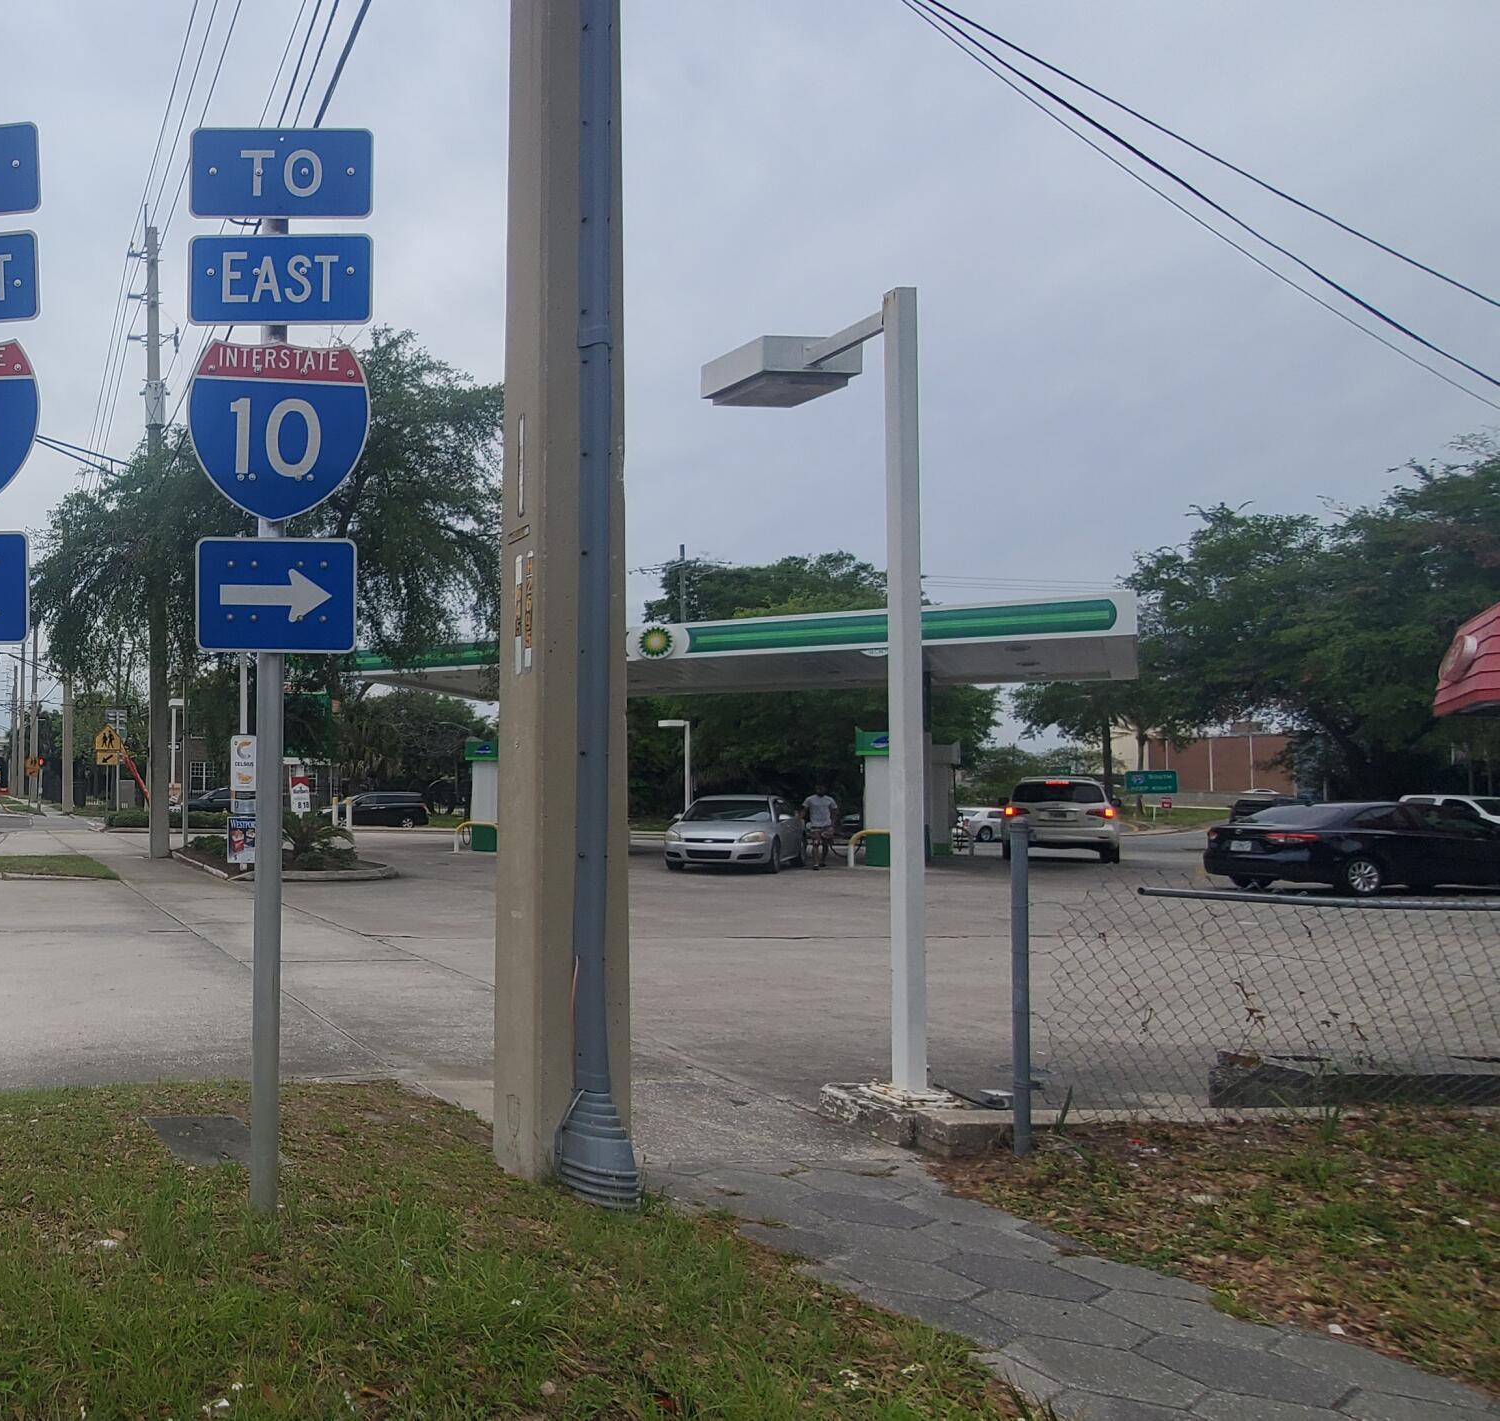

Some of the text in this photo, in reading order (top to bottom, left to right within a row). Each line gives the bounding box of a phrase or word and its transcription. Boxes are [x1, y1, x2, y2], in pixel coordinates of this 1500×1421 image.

[240, 149, 322, 197] TO
[221, 251, 339, 303] EAST
[218, 346, 340, 373] INTERSTATE
[229, 397, 321, 478] 10
[230, 820, 256, 828] WESTPOR
